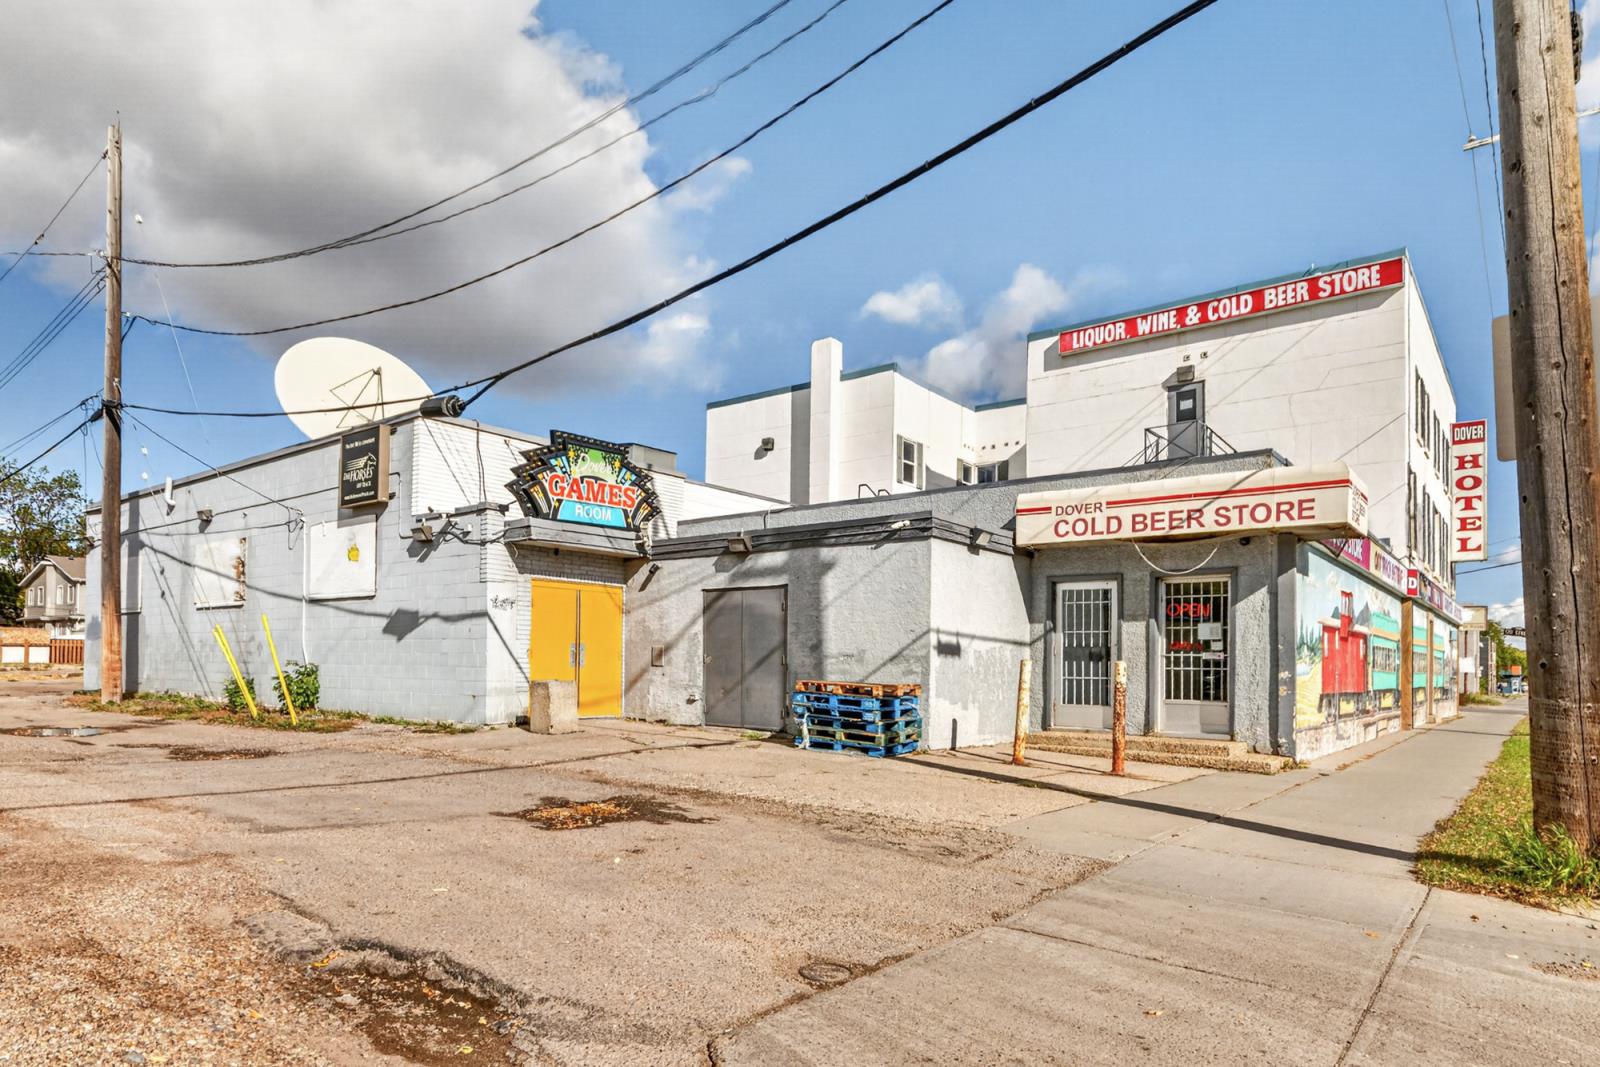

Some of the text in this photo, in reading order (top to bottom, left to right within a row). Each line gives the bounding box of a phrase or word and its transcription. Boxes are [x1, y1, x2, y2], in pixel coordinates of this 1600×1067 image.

[1185, 304, 1202, 326] &
[1207, 294, 1253, 321] COLD
[1264, 281, 1310, 310] BEER
[1318, 264, 1381, 298] STORE
[1454, 425, 1484, 441] DOVER
[547, 473, 637, 510] GAMES
[1454, 453, 1483, 553] HOTEL
[575, 504, 613, 521] ROOM
[1053, 498, 1316, 538] COLD BEER STORE
[1055, 502, 1104, 516] DOVER
[1167, 602, 1210, 618] OPEN
